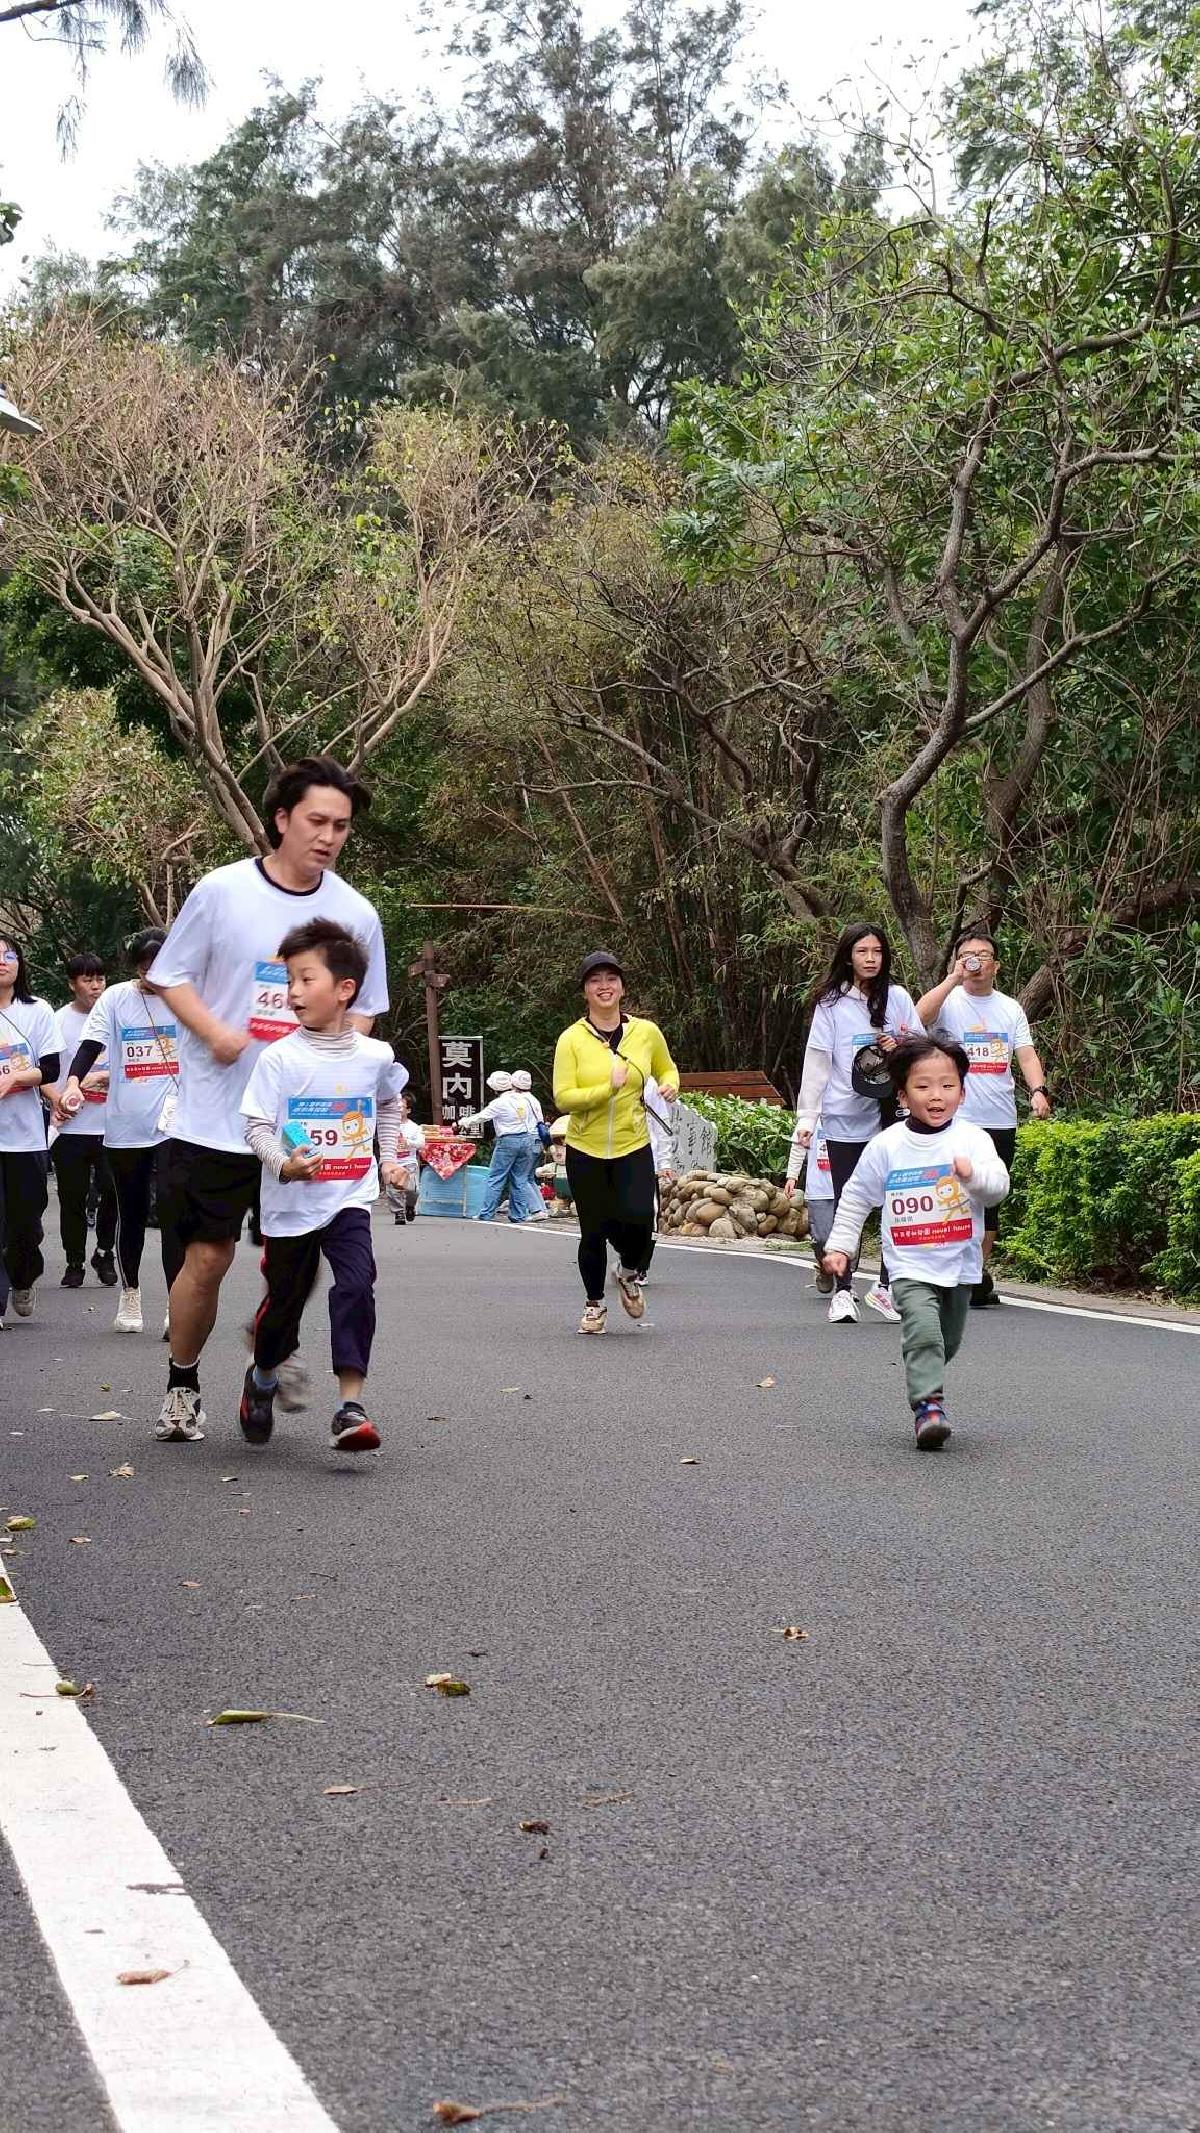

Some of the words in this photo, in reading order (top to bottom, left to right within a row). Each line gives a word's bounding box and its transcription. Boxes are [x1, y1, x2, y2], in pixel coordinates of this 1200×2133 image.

[127, 1046, 152, 1057] 037
[967, 1047, 989, 1057] 418
[442, 1105, 476, 1120] 咖啡
[892, 1196, 933, 1215] 090
